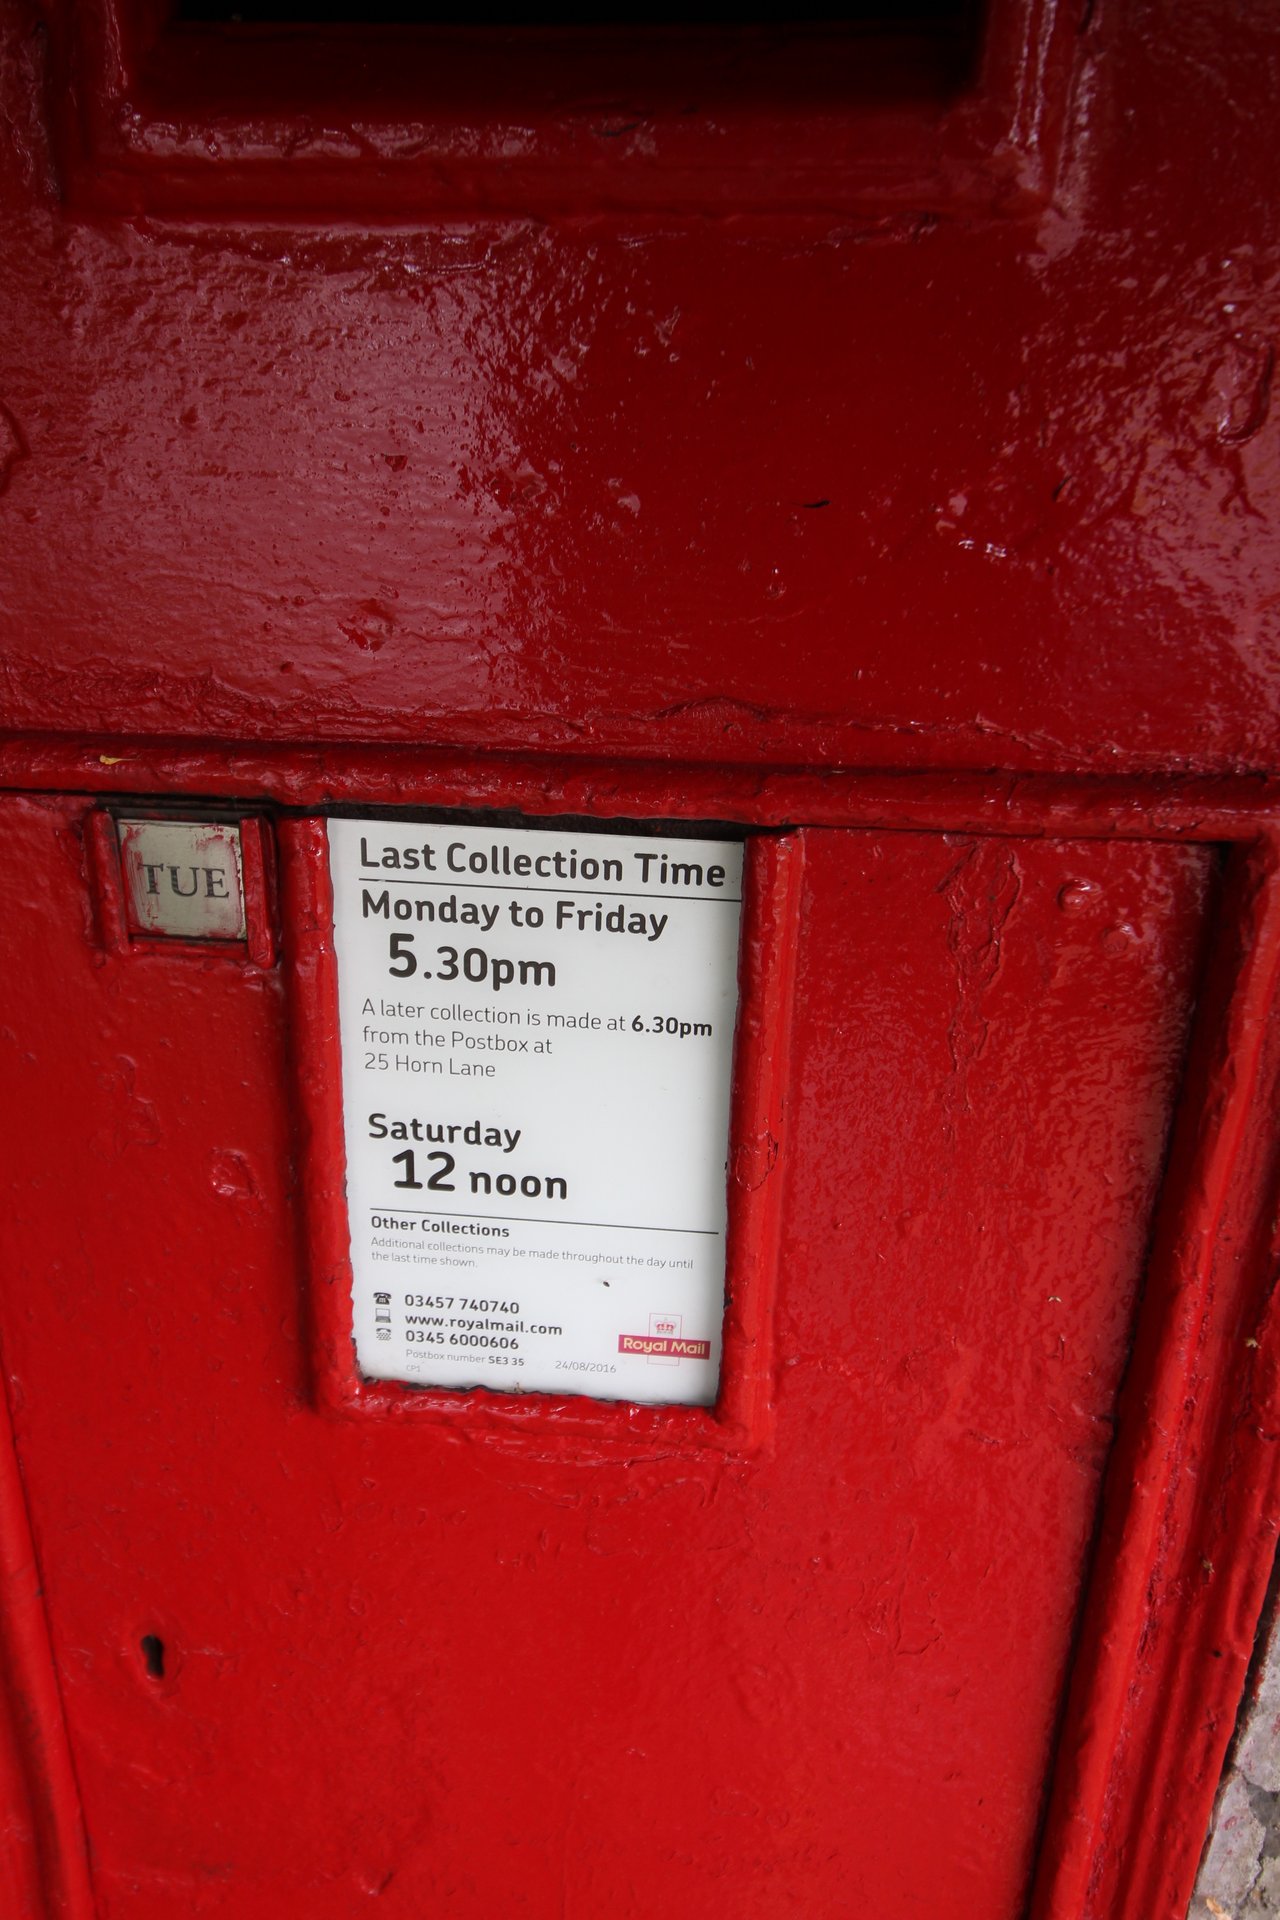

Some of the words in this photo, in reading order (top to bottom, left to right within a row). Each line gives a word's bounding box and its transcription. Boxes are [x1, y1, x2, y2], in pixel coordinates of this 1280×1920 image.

[359, 837, 437, 871] Last
[446, 842, 623, 881] Collection
[634, 853, 726, 887] Time
[137, 863, 230, 898] TUE
[362, 889, 499, 931] Monday
[509, 901, 544, 929] to
[556, 900, 668, 941] Friday
[388, 932, 556, 991] 5.30pm
[362, 998, 375, 1016] A
[380, 1000, 425, 1019] later
[430, 1004, 521, 1025] collection
[527, 1009, 541, 1026] is
[547, 1011, 601, 1030] made
[606, 1015, 626, 1032] at
[631, 1015, 713, 1039] 6.30pm
[363, 1027, 409, 1045] from
[414, 1029, 446, 1048] the
[452, 1031, 529, 1052] Postbox
[533, 1038, 553, 1054] at
[364, 1053, 389, 1071] 25
[395, 1055, 443, 1074] Horn
[449, 1057, 496, 1077] Lane
[368, 1113, 521, 1153] Saturday
[392, 1149, 456, 1191] 12
[469, 1170, 567, 1199] noon
[371, 1216, 416, 1230] Other
[421, 1219, 510, 1237] Collections
[371, 1237, 425, 1250] Additional
[427, 1241, 484, 1255] collections
[487, 1247, 509, 1257] may
[512, 1247, 526, 1257] be
[529, 1250, 559, 1260] made
[562, 1251, 624, 1264] throughout
[626, 1255, 644, 1266] the
[647, 1257, 666, 1269] day
[669, 1260, 694, 1269] until
[371, 1251, 389, 1261] the
[392, 1252, 410, 1263] last
[413, 1254, 437, 1265] time
[440, 1256, 478, 1268] shown.
[404, 1294, 454, 1309] 03457
[459, 1298, 520, 1314] 740740
[405, 1314, 563, 1335] www.royalmail.com
[405, 1330, 445, 1344] 0345
[450, 1333, 519, 1350] 6000606
[623, 1337, 667, 1353] Royal
[671, 1341, 705, 1355] Mail
[406, 1349, 445, 1360] Postbox
[447, 1353, 485, 1364] number
[488, 1355, 509, 1365] SE3
[511, 1357, 525, 1366] 35
[555, 1360, 617, 1373] 24/08/2016
